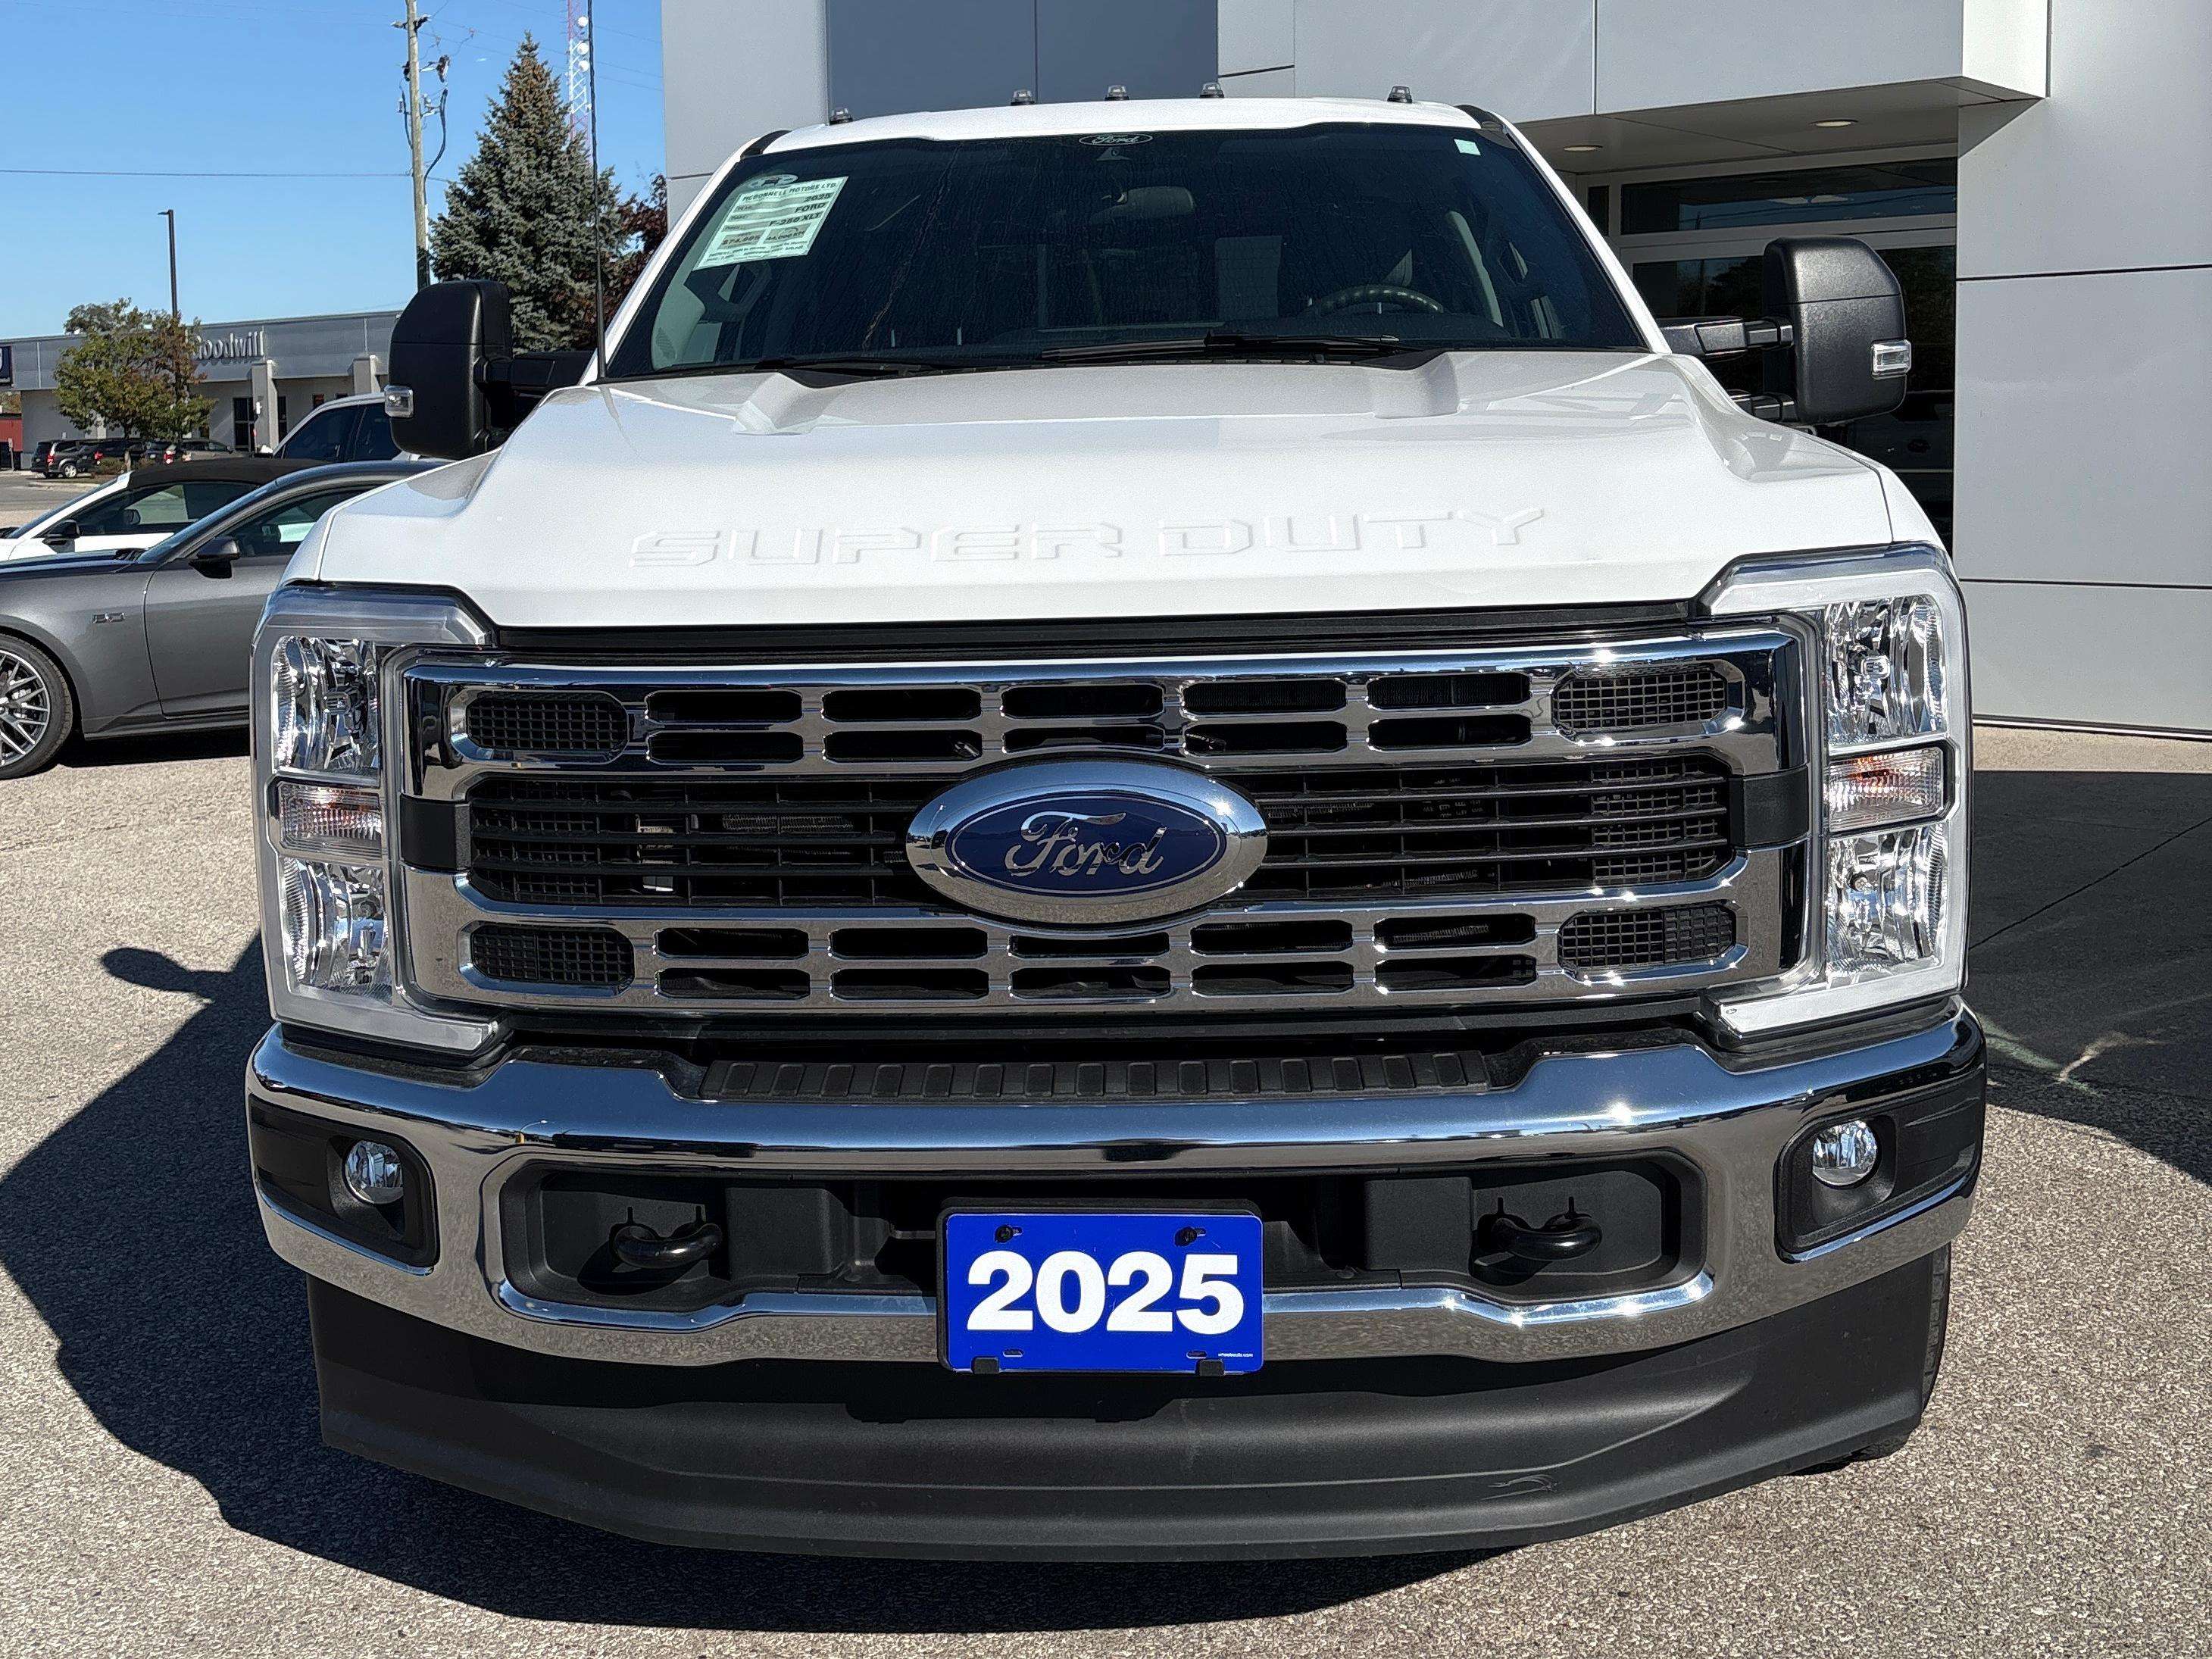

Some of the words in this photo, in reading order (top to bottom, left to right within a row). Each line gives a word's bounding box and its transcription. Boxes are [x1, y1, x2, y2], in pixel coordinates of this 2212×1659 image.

[1092, 134, 1140, 145] Ford
[789, 185, 820, 194] MOTORS
[795, 202, 826, 213] FORD
[769, 216, 801, 227] F-250
[801, 212, 822, 222] XLT
[628, 521, 1123, 568] SUPER
[1158, 507, 1545, 558] DUTY
[1004, 811, 1168, 877] Ford
[967, 1250, 1245, 1335] 2025
